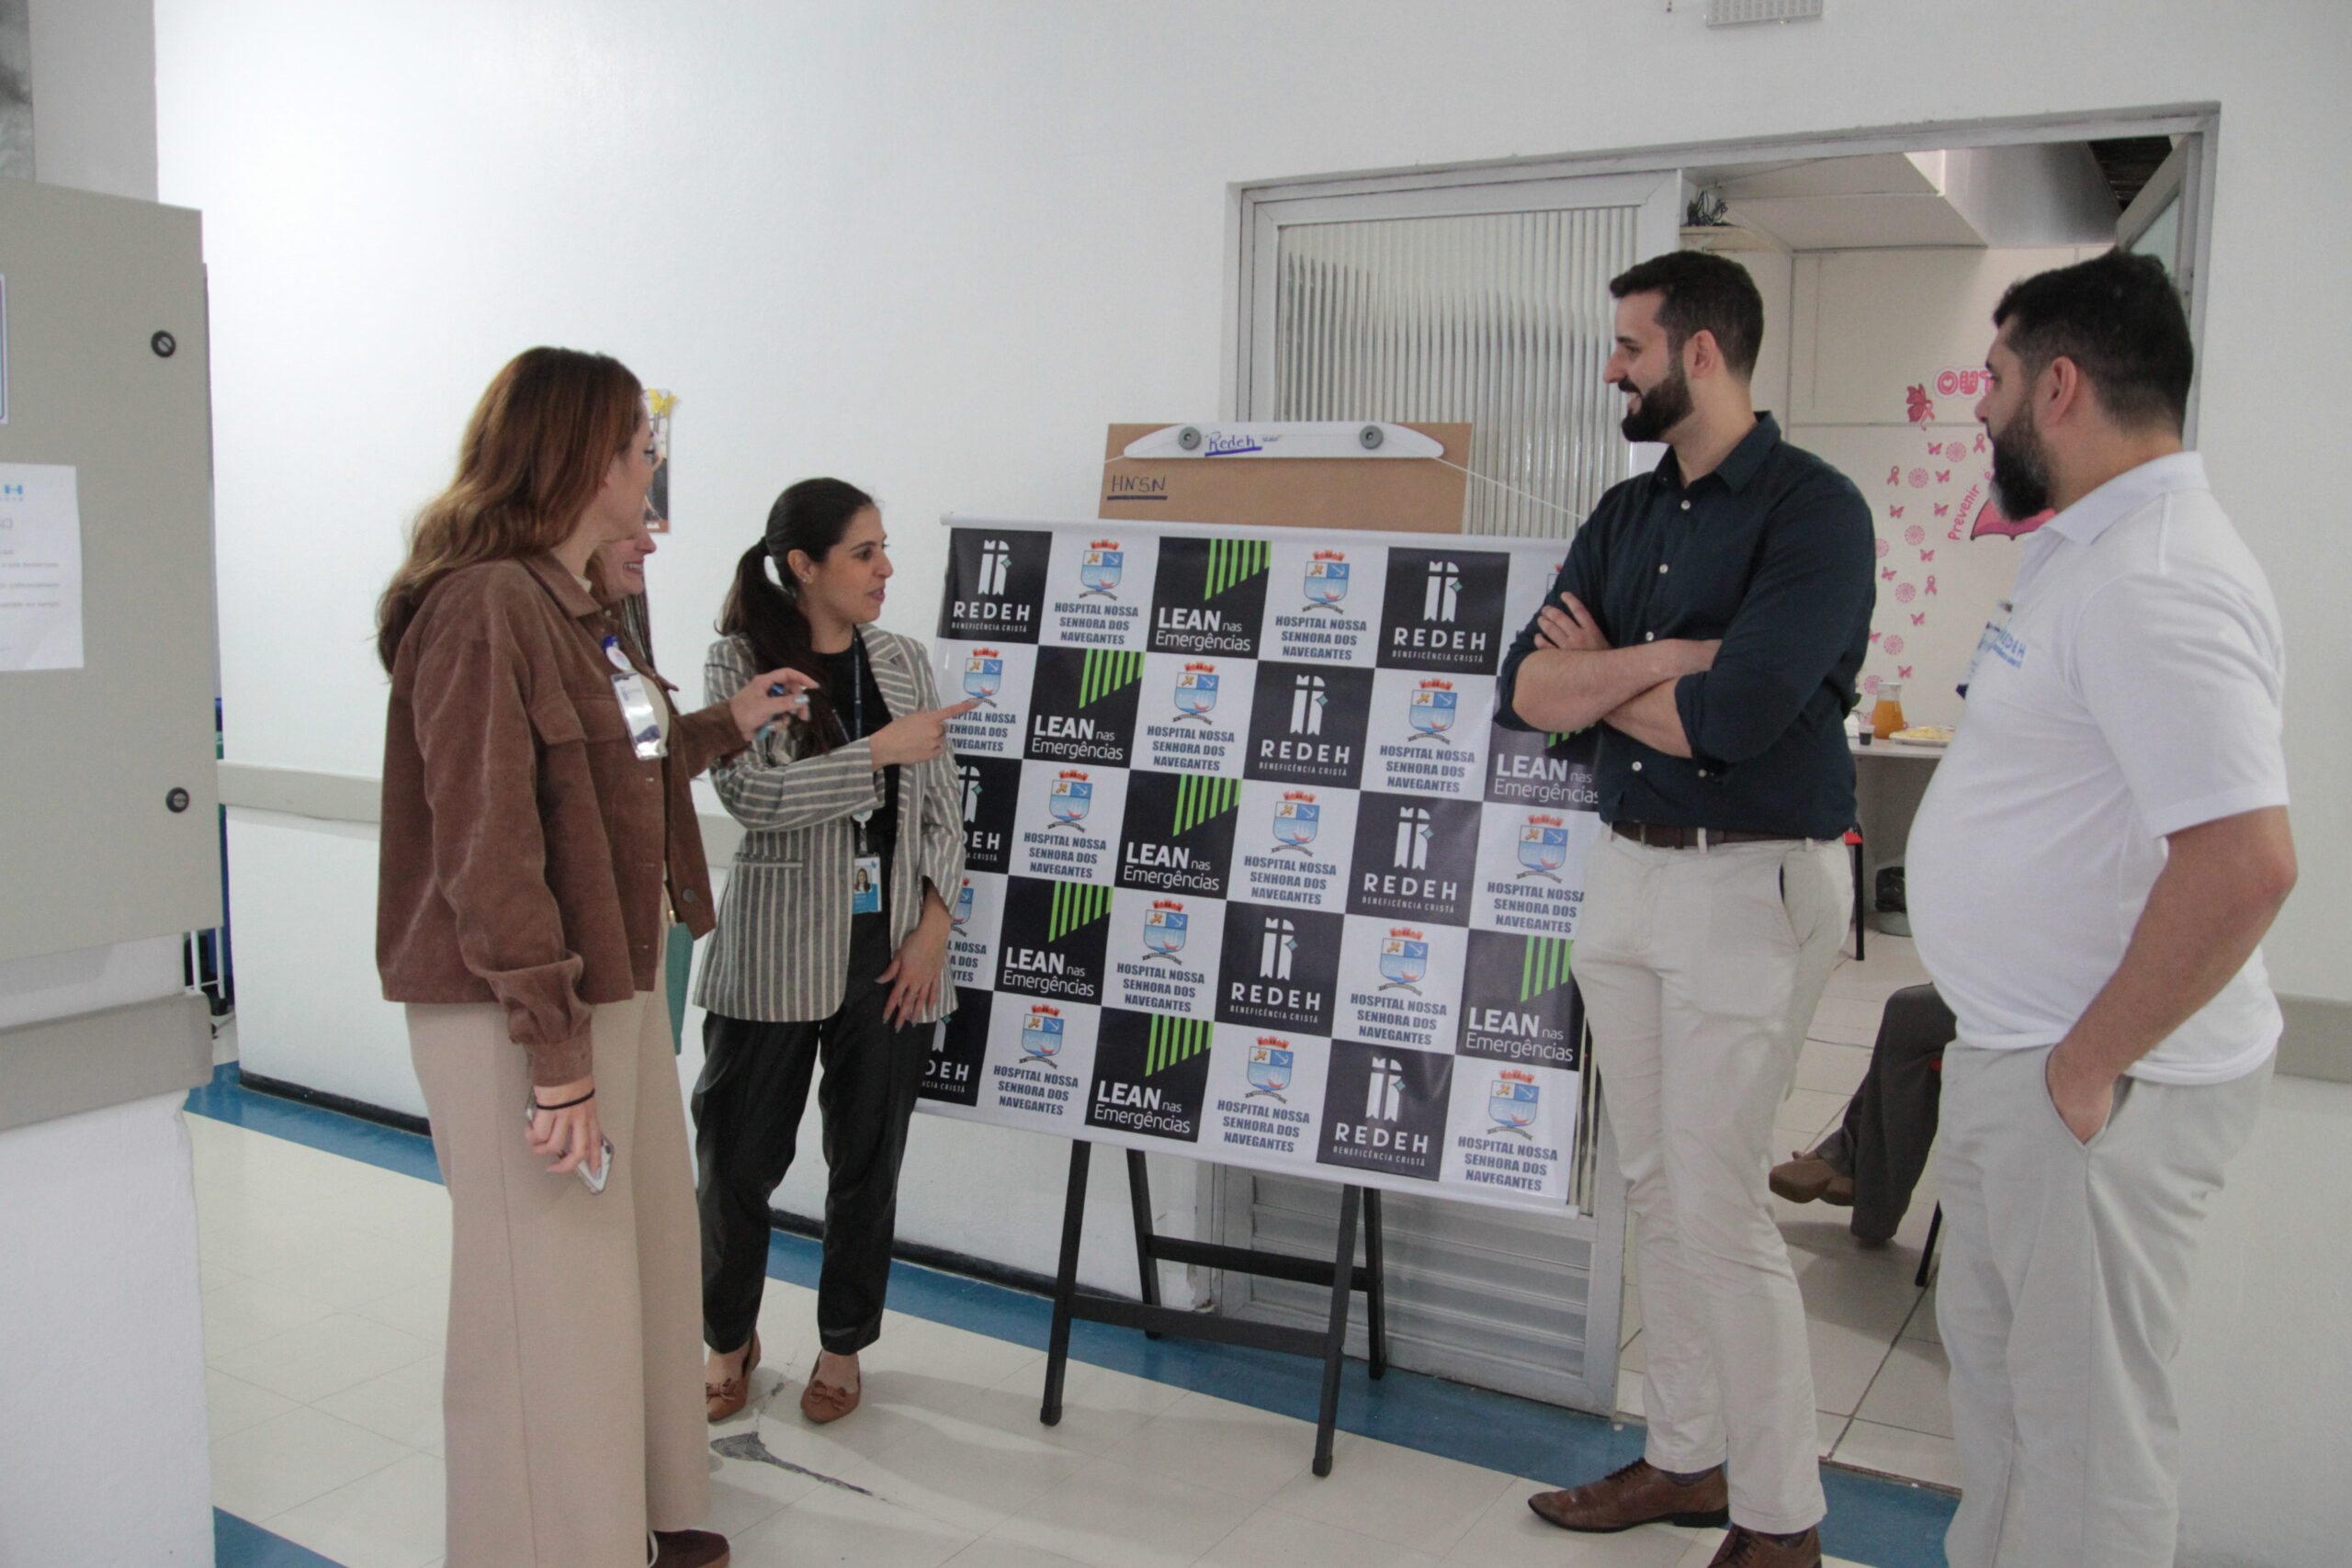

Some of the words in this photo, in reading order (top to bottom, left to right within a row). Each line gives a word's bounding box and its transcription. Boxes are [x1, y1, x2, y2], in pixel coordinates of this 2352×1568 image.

[1947, 484, 1980, 541] Prevenir
[953, 601, 1030, 621] REDEH
[1054, 603, 1102, 615] HOSPITAL
[1103, 605, 1138, 617] NOSSA
[1158, 607, 1221, 632] LEAN
[1222, 622, 1242, 632] nas
[1059, 616, 1106, 629] SENHORA
[1108, 620, 1129, 631] DOS
[1275, 615, 1327, 629] HOSPITAL
[1329, 619, 1367, 631] NOSSA
[1060, 631, 1125, 645] NAVEGANTES
[1156, 630, 1250, 651] Emergências
[1281, 631, 1331, 644] SENHORA
[1334, 634, 1357, 646] DOS
[1394, 627, 1486, 650] REDEH
[1283, 646, 1352, 660] NAVEGANTES
[985, 713, 1016, 724] NOSSA
[1034, 715, 1095, 740] LEAN
[1096, 731, 1115, 741] nas
[949, 724, 987, 737] ENHORA
[989, 727, 1008, 738] DOS
[1147, 726, 1196, 739] HOSPITAL
[1198, 729, 1235, 743] NOSSA
[1032, 738, 1124, 761] Emergências
[1152, 740, 1201, 754] SENHORA
[1203, 745, 1225, 757] DOS
[1261, 739, 1350, 764] REDEH
[1380, 745, 1433, 760] HOSPITAL
[1435, 750, 1475, 763] NOSSA
[1153, 755, 1220, 771] NAVEGANTES
[1386, 761, 1438, 775] SENHORA
[1441, 765, 1464, 778] DOS
[1496, 753, 1567, 782] LEAN
[1570, 773, 1592, 783] nas
[1387, 776, 1459, 793] NAVEGANTES
[1023, 832, 1069, 846] HOSPITAL
[1072, 837, 1106, 851] NOSSA
[1029, 847, 1074, 862] SENHORA
[1076, 852, 1097, 864] DOS
[1126, 841, 1190, 869] LEAN
[1191, 860, 1211, 871] nas
[1244, 855, 1296, 872] HOSPITAL
[1299, 862, 1337, 875] NOSSA
[1030, 862, 1092, 878] NAVEGANTES
[1124, 864, 1220, 891] Emergências
[1250, 871, 1301, 887] SENHORA
[1304, 877, 1327, 890] DOS
[1363, 873, 1457, 901] REDEH
[1487, 882, 1544, 898] HOSPITAL
[1251, 886, 1321, 905] NAVEGANTES
[1494, 898, 1549, 915] SENHORA
[1552, 905, 1577, 918] DOS
[1496, 914, 1572, 933] NAVEGANTES
[954, 941, 987, 954] NOSSA
[957, 955, 978, 968] DOS
[1005, 947, 1065, 975] LEAN
[1067, 966, 1085, 977] nas
[1002, 969, 1094, 997] Emergências
[1116, 963, 1166, 979] HOSPITAL
[1169, 969, 1204, 984] NOSSA
[1123, 978, 1171, 995] SENHORA
[1173, 985, 1195, 998] DOS
[1231, 982, 1320, 1011] REDEH
[1125, 994, 1191, 1012] NAVEGANTES
[1351, 993, 1404, 1010] HOSPITAL
[1408, 1000, 1447, 1016] NOSSA
[1357, 1010, 1409, 1027] SENHORA
[1412, 1017, 1437, 1031] DOS
[1468, 1007, 1540, 1038] LEAN
[1542, 1028, 1564, 1040] nas
[1359, 1025, 1431, 1045] NAVEGANTES
[1465, 1032, 1573, 1062] Emergências
[993, 1065, 1041, 1082] HOSPITAL
[1044, 1073, 1079, 1088] NOSSA
[998, 1080, 1045, 1098] SENHORA
[1046, 1089, 1069, 1101] DOS
[1097, 1080, 1161, 1111] LEAN
[1162, 1101, 1182, 1113] nas
[999, 1095, 1064, 1115] NAVEGANTES
[1217, 1100, 1270, 1118] HOSPITAL
[1272, 1108, 1310, 1123] NOSSA
[1094, 1103, 1191, 1134] Emergências
[1223, 1116, 1274, 1134] SENHORA
[1276, 1124, 1300, 1138] DOS
[1224, 1132, 1295, 1153] NAVEGANTES
[1335, 1122, 1429, 1154] REDEH
[1458, 1136, 1514, 1155] HOSPITAL
[1517, 1145, 1557, 1161] NOSSA
[1464, 1153, 1520, 1172] SENHORA
[1521, 1161, 1547, 1176] DOS
[1465, 1169, 1542, 1191] NAVEGANTES
